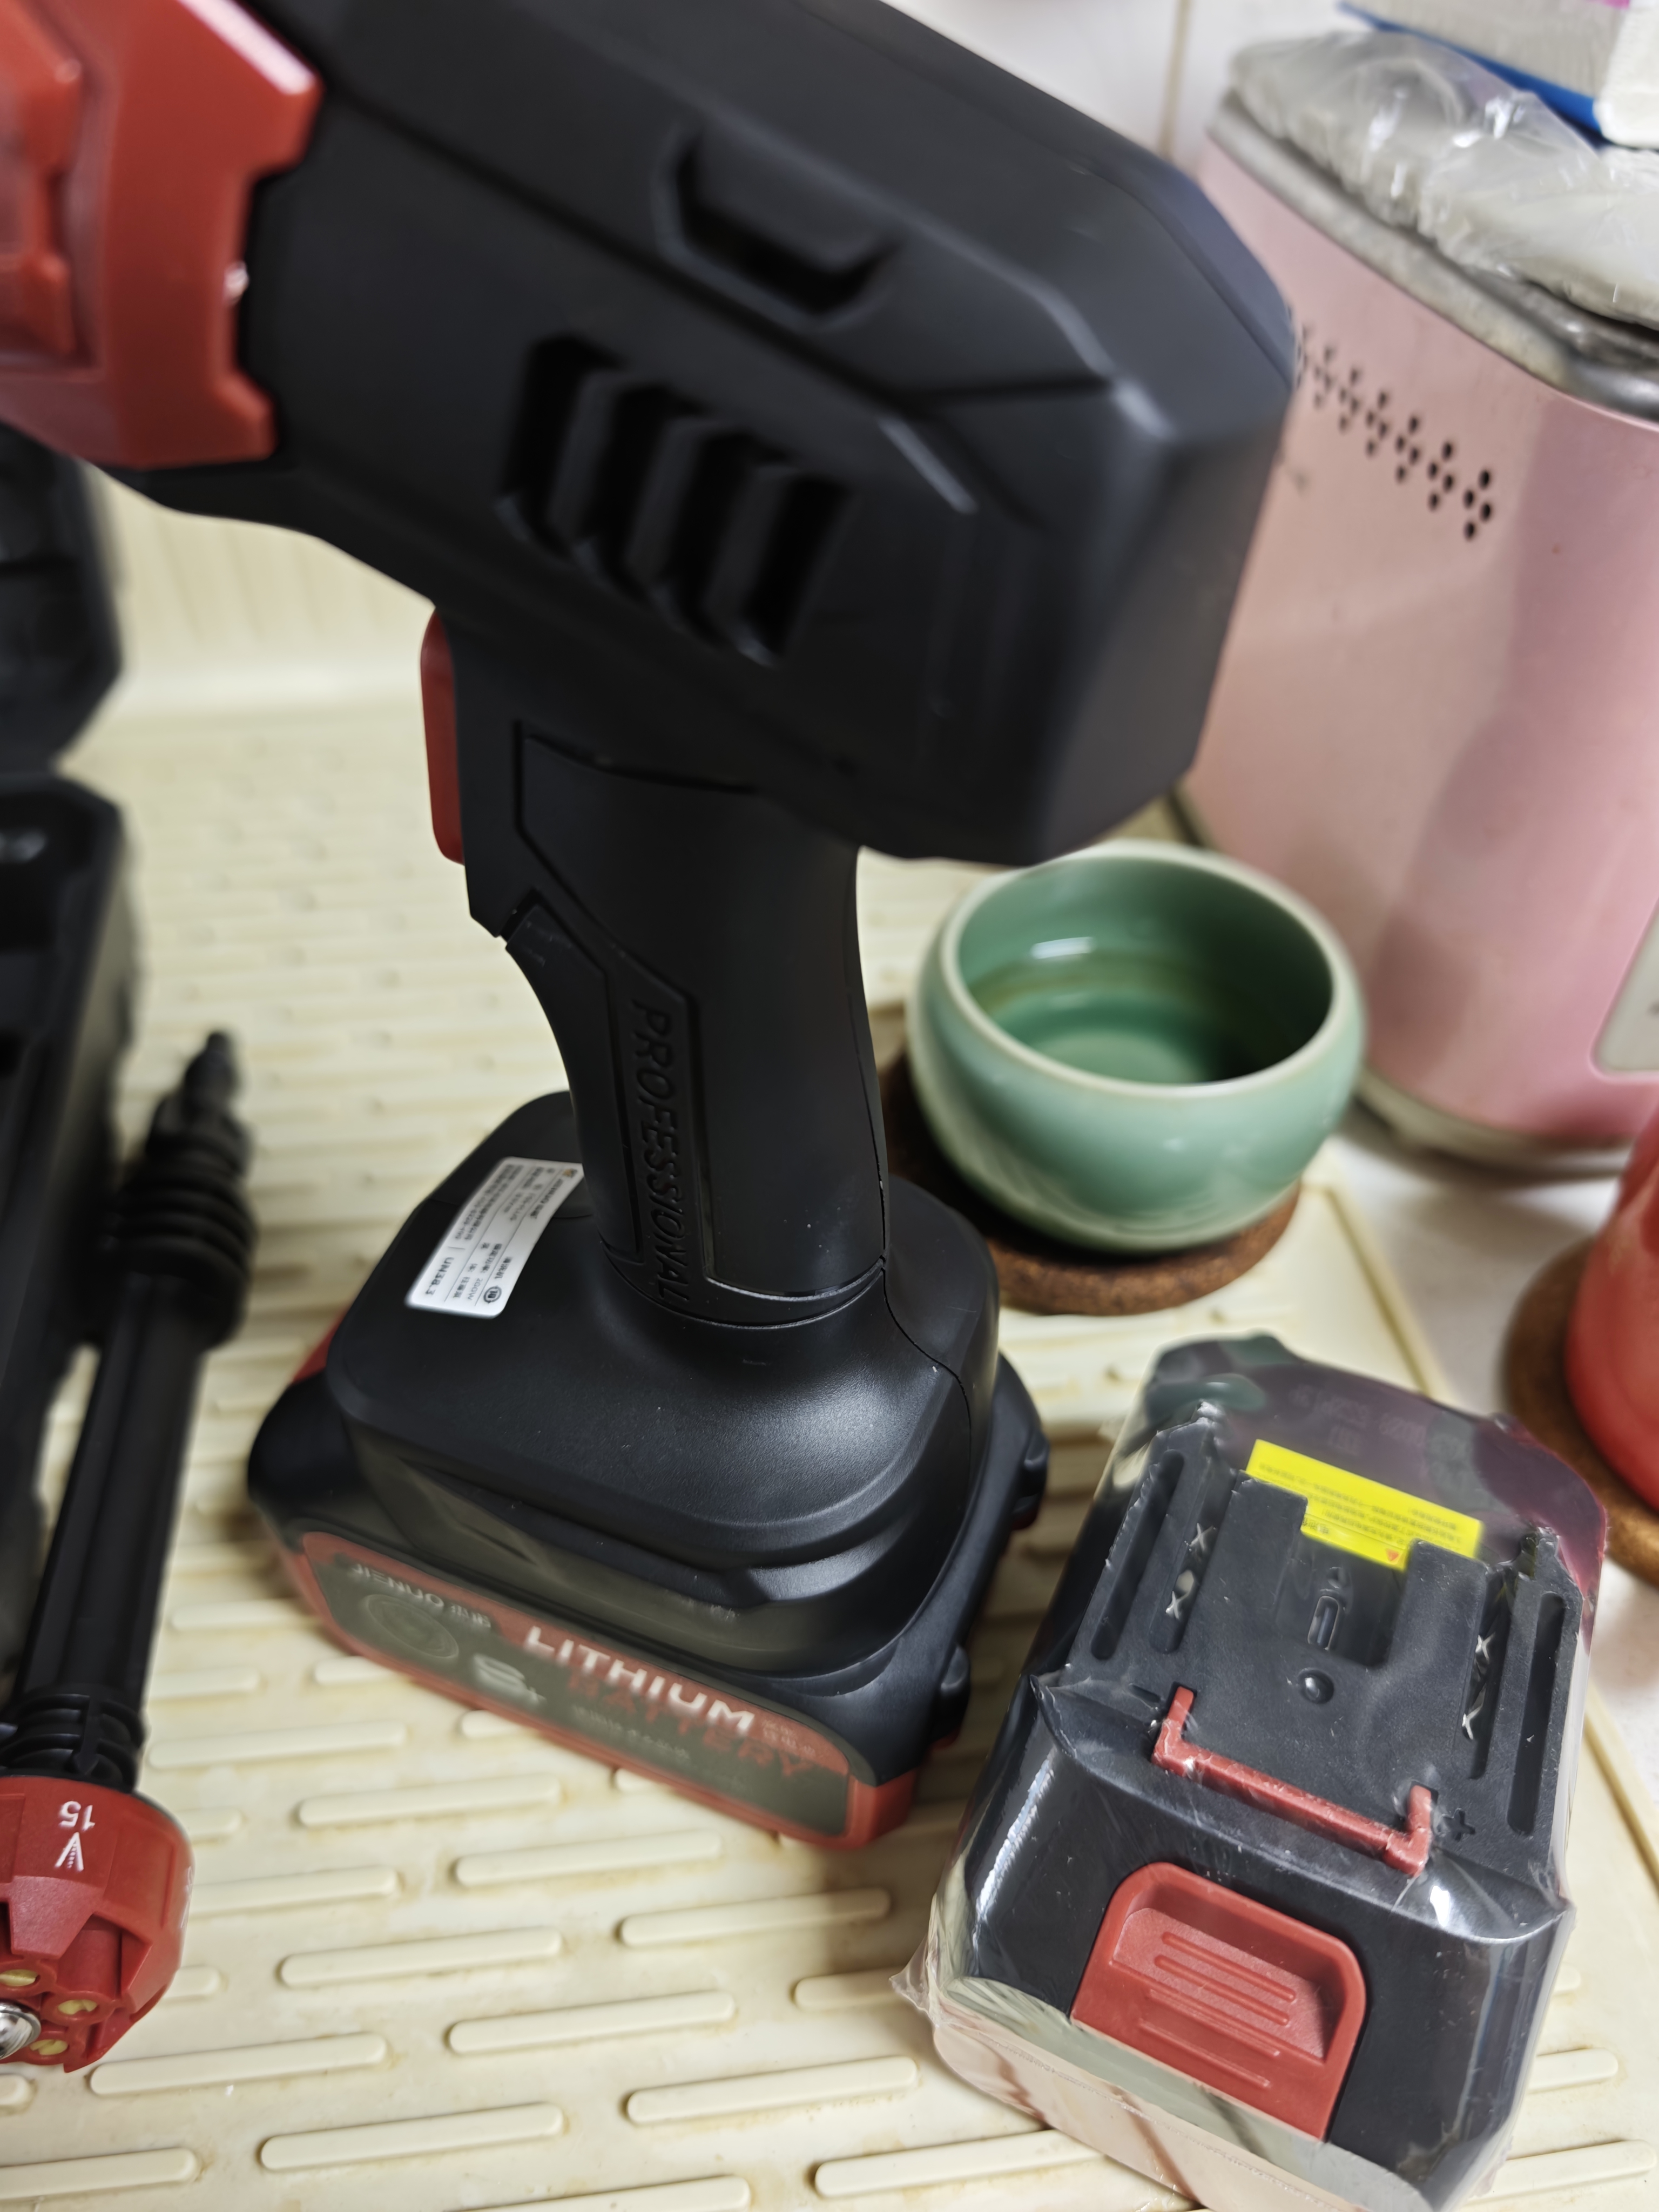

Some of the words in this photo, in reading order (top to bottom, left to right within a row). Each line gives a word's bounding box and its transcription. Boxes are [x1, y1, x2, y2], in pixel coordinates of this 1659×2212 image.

[631, 998, 690, 1301] PROFESSIONAL
[426, 1257, 455, 1295] UN38.3
[468, 1278, 483, 1300] 200W
[352, 1564, 444, 1607] JIENUO
[525, 1626, 755, 1735] LITHIUM
[59, 1800, 96, 1830] 15
